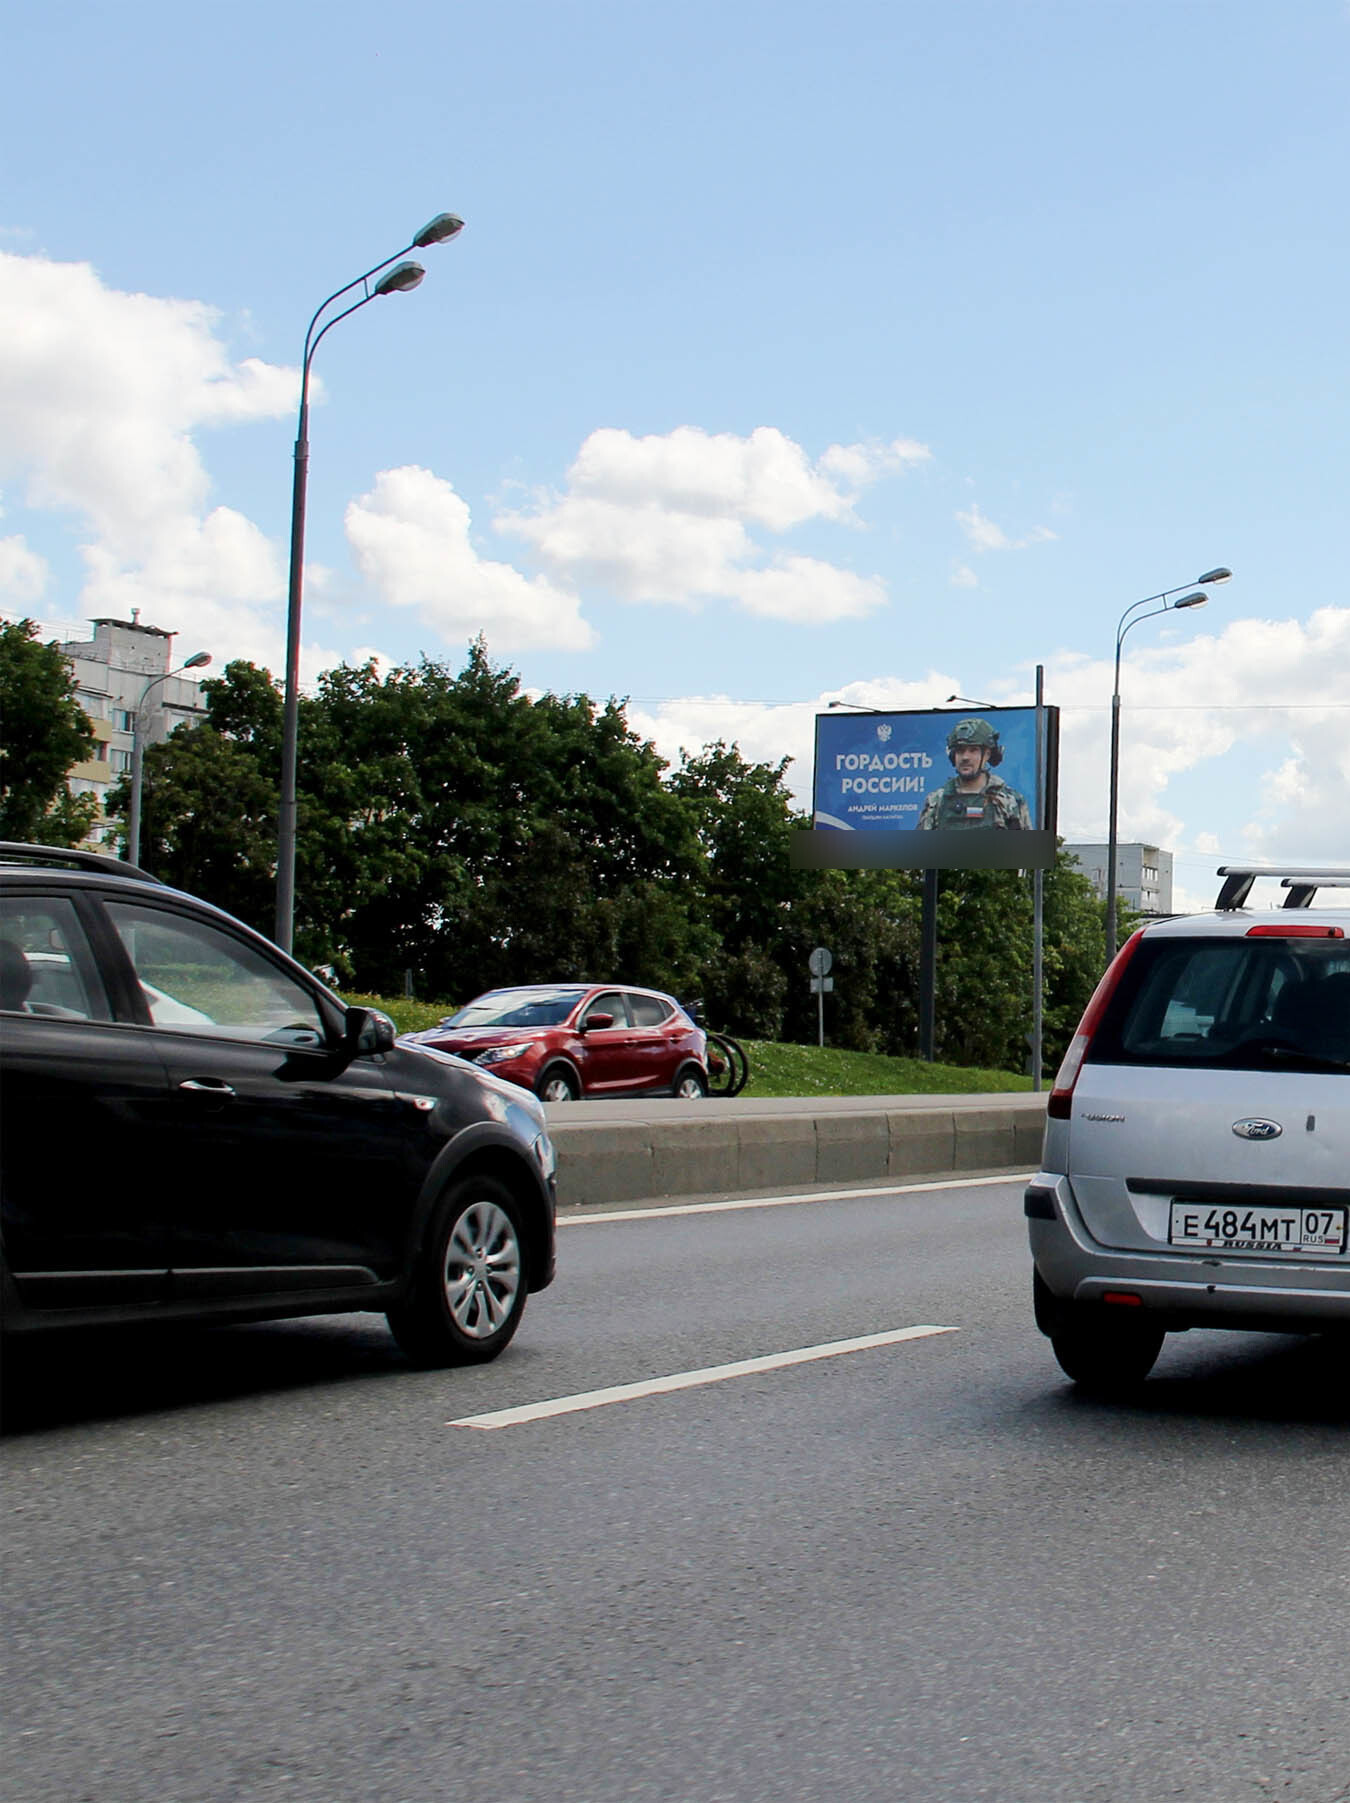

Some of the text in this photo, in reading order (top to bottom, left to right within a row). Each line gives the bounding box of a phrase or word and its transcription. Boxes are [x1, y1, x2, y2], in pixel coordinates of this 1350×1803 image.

[836, 752, 933, 771] ГОРДОСТЬ
[841, 777, 925, 794] РОССИИ!
[848, 803, 877, 813] АНДРЕЙ
[1183, 1209, 1334, 1242] Е484МТ 07
[1223, 1240, 1283, 1251] RUSSIA
[1303, 1234, 1324, 1244] RUS
